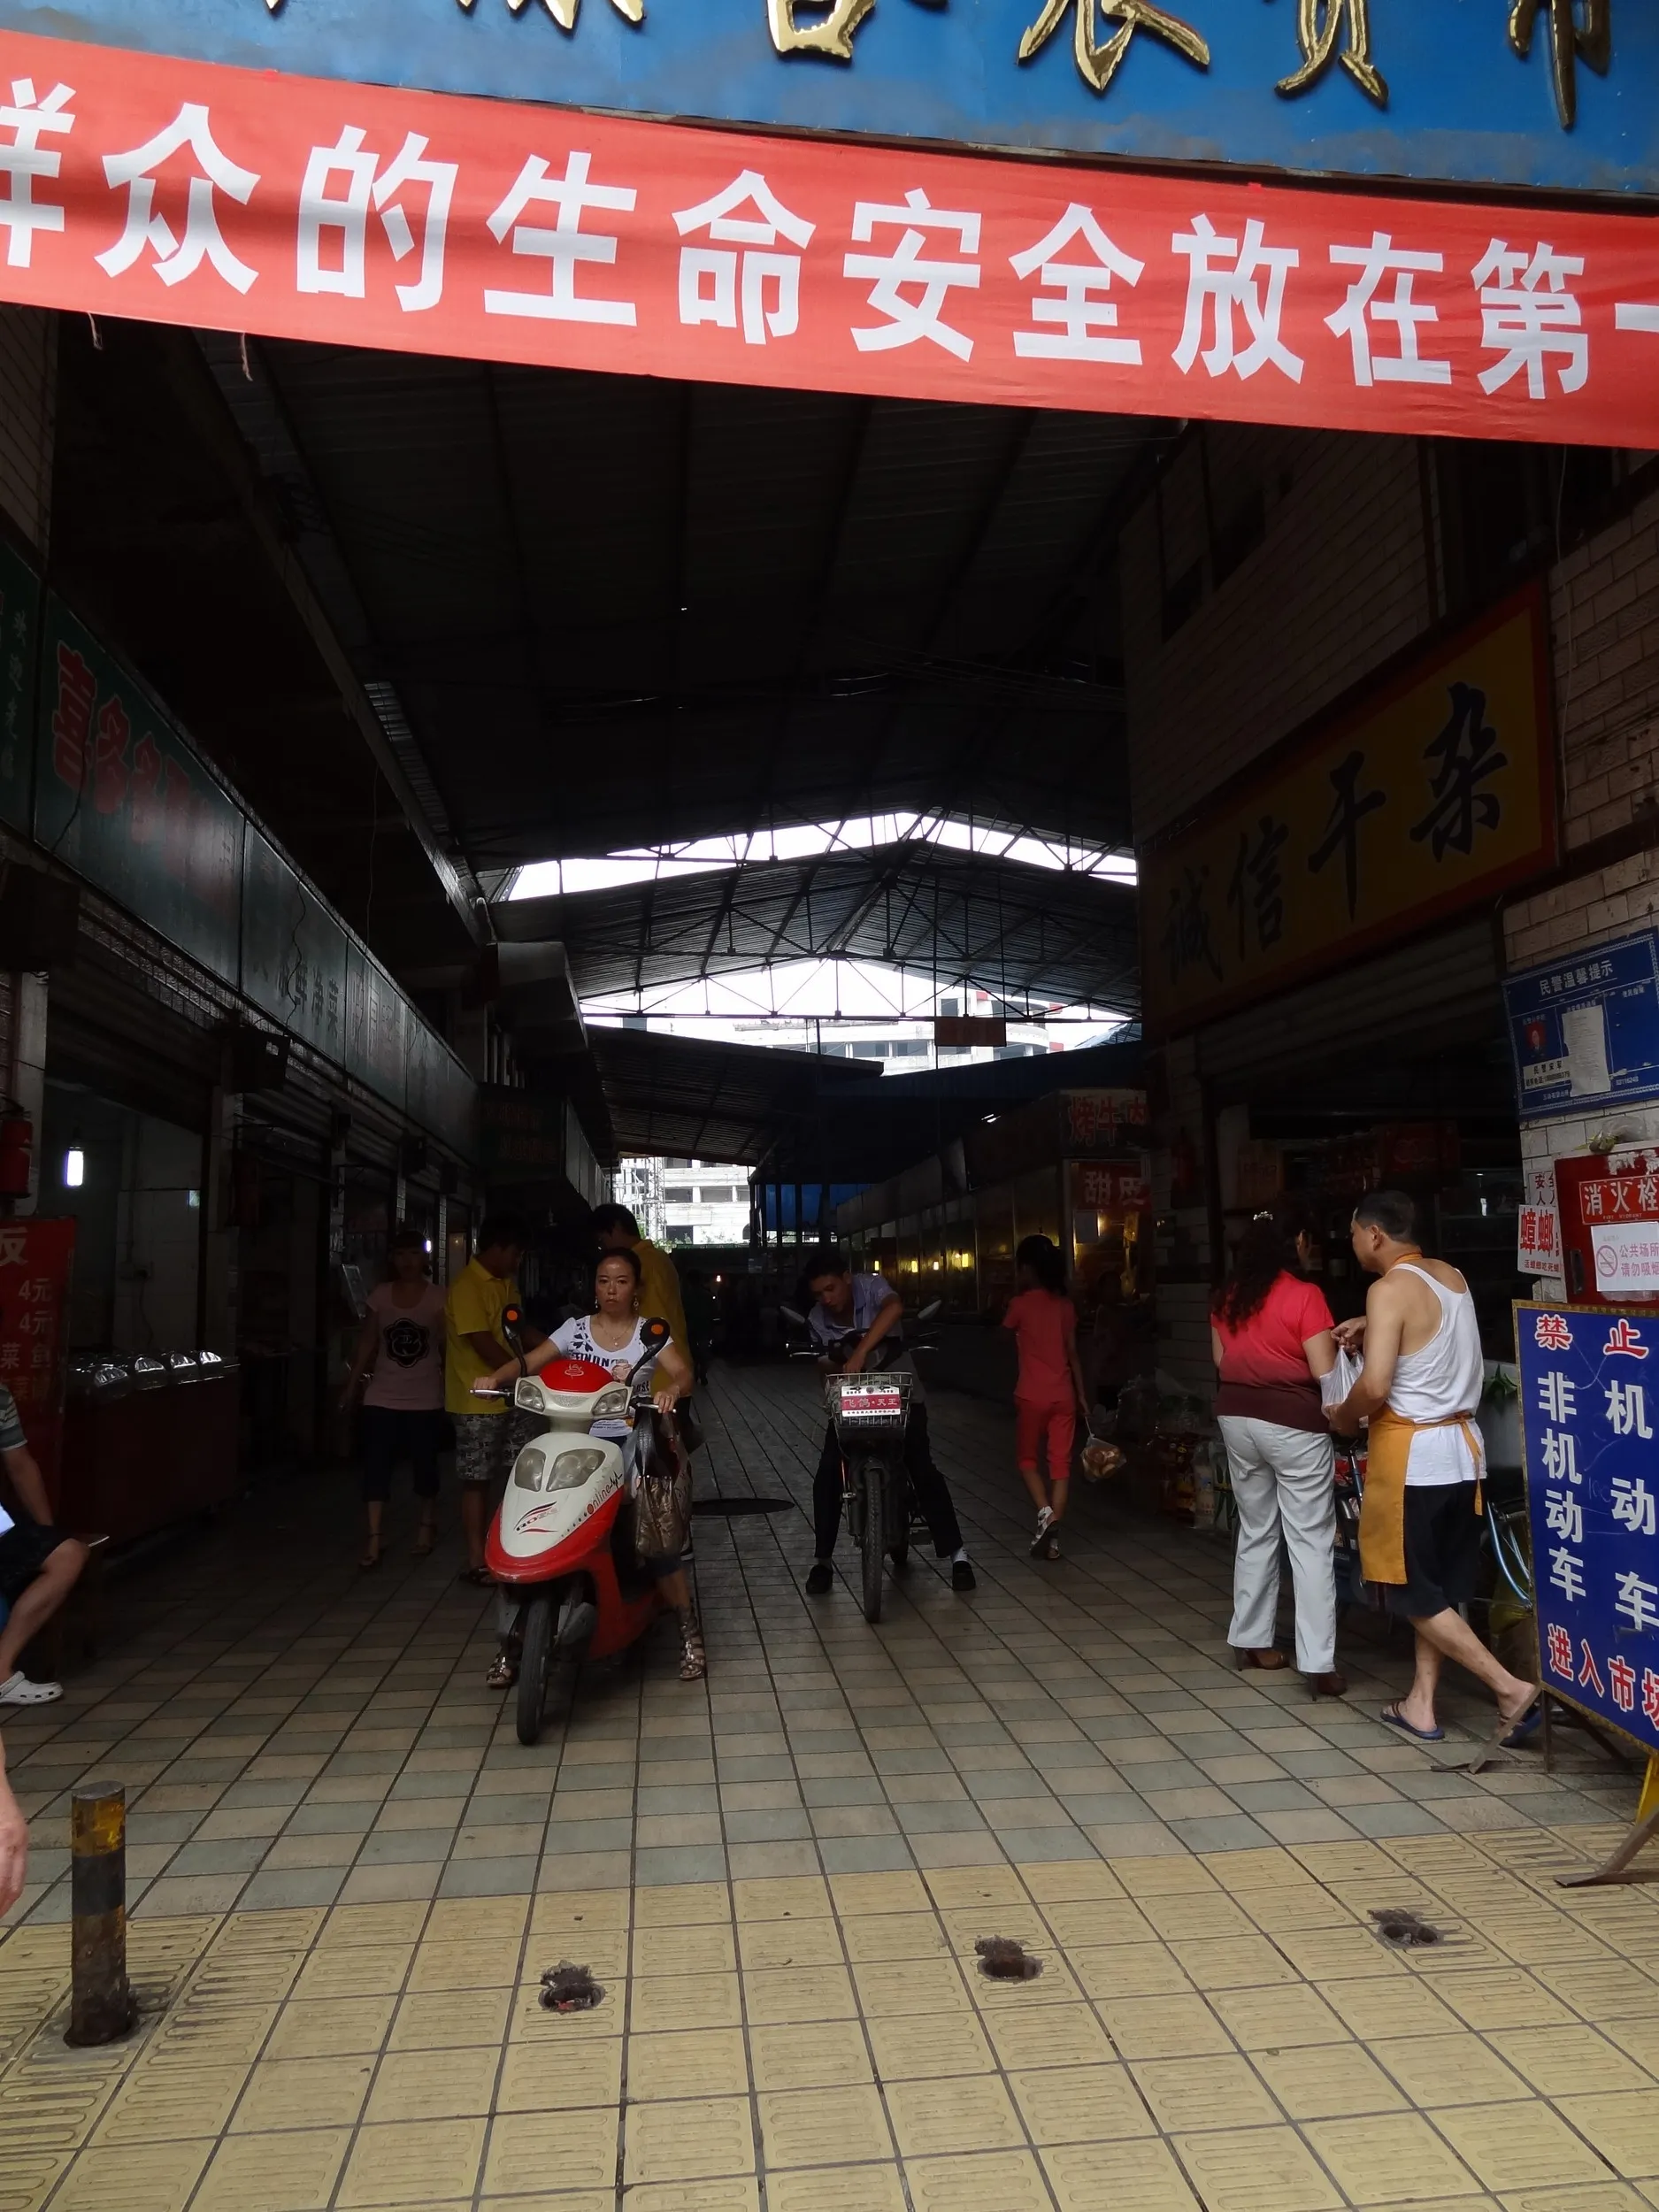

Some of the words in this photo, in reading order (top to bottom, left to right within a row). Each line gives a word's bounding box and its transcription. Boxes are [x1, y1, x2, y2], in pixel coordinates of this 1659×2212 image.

[1539, 959, 1614, 996] 民警温馨提示
[1584, 1176, 1659, 1216] 消火栓
[1520, 1207, 1554, 1258] 蟑螂
[1619, 1242, 1659, 1258] 公共场所
[1621, 1261, 1659, 1277] 请勿吸烟
[19, 1277, 51, 1303] 4元
[19, 1310, 52, 1336] 4元
[1534, 1313, 1650, 1361] 禁止
[587, 1484, 612, 1515] Online
[1538, 1371, 1586, 1602] 非机动车
[1604, 1379, 1659, 1631] 机动车
